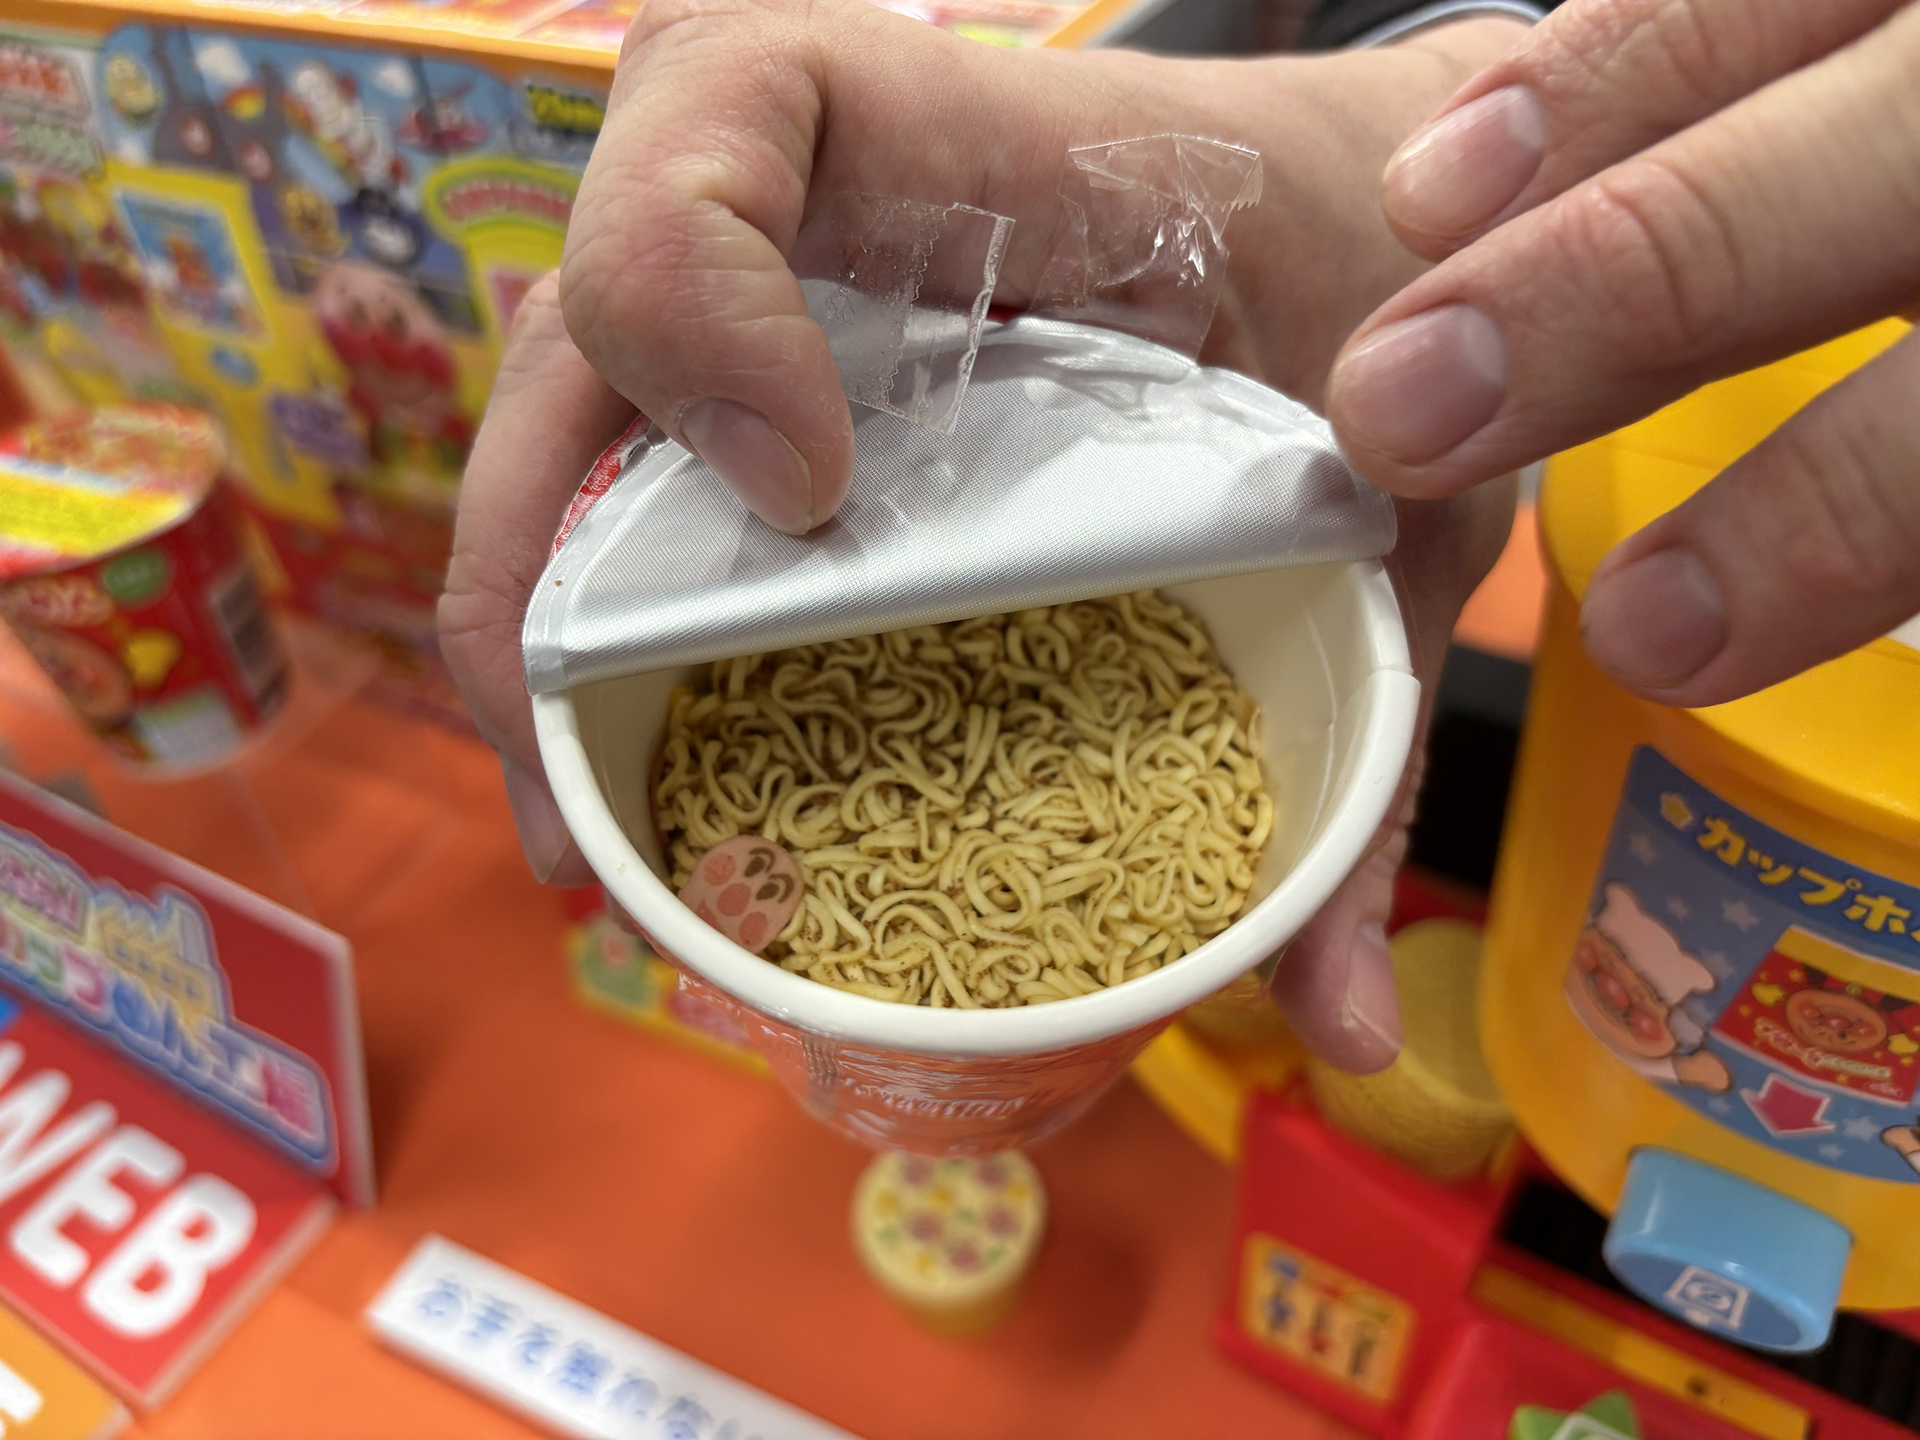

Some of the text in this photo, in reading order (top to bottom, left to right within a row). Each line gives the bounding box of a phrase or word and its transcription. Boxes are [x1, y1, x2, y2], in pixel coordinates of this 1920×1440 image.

[1697, 816, 1920, 945] カップホ
[0, 1038, 258, 1340] WEB
